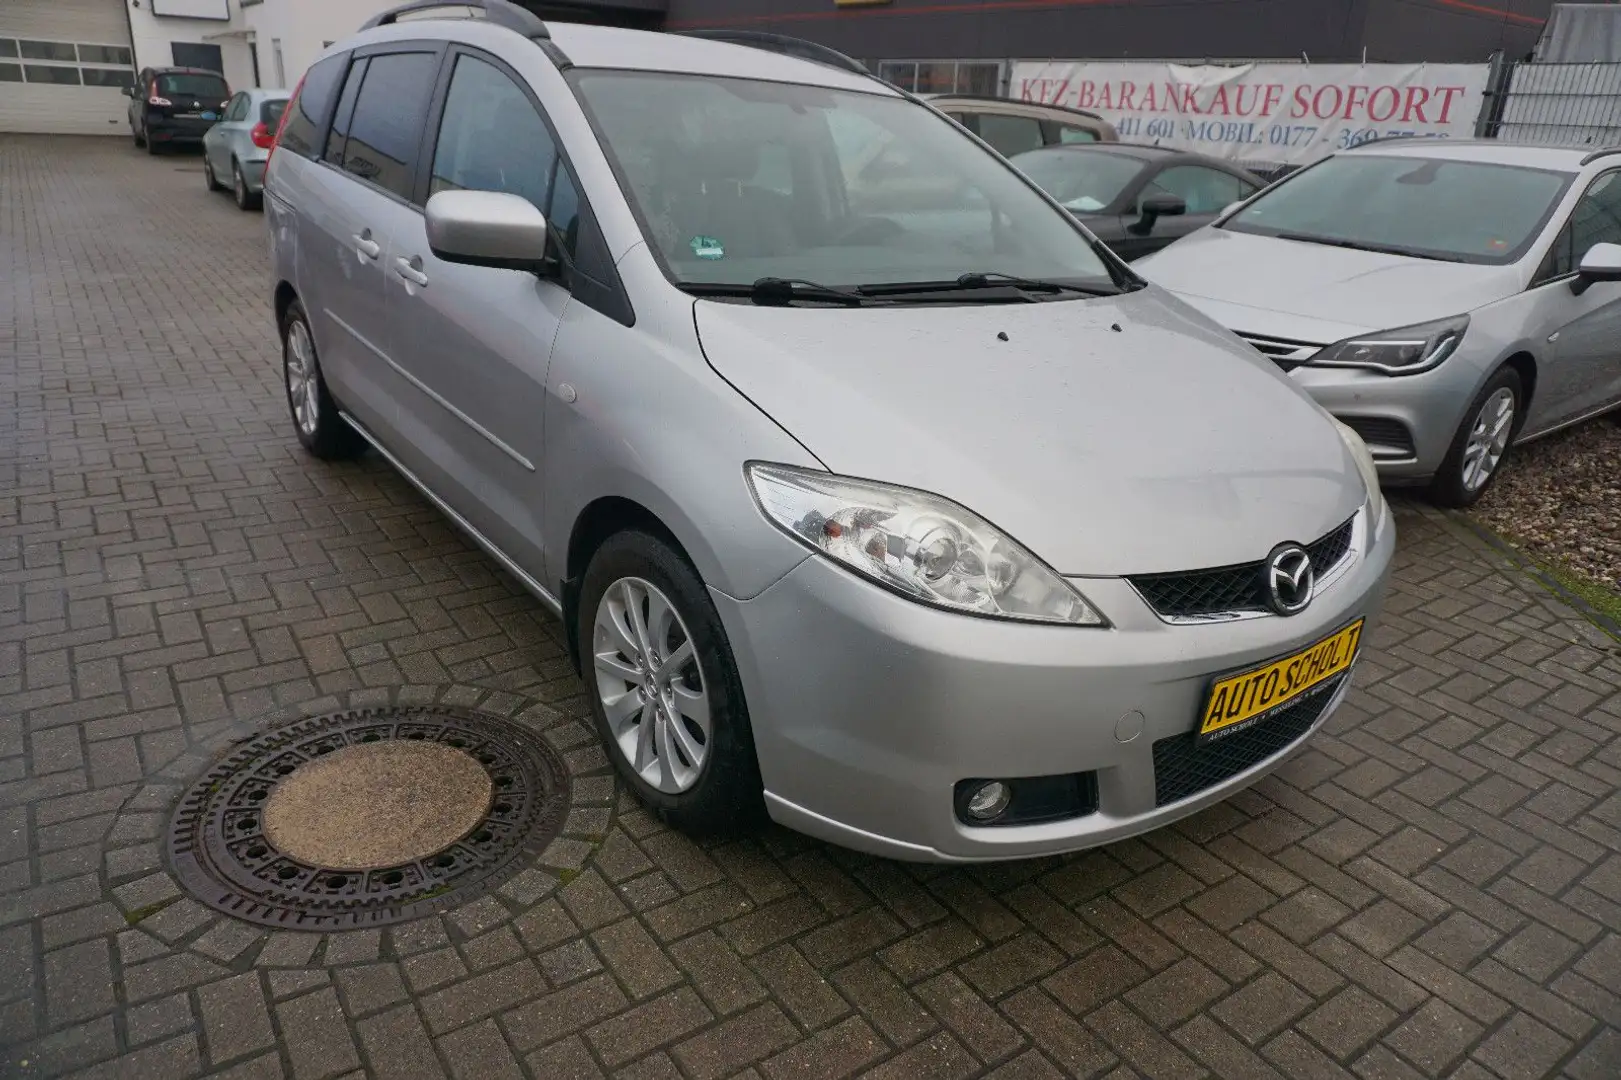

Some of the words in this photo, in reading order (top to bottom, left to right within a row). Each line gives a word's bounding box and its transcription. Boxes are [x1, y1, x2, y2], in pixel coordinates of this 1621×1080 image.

[1290, 83, 1466, 124] SOFORT
[1146, 119, 1175, 139] 601
[1186, 120, 1263, 145] MOBIL:
[1269, 124, 1318, 147] 0177
